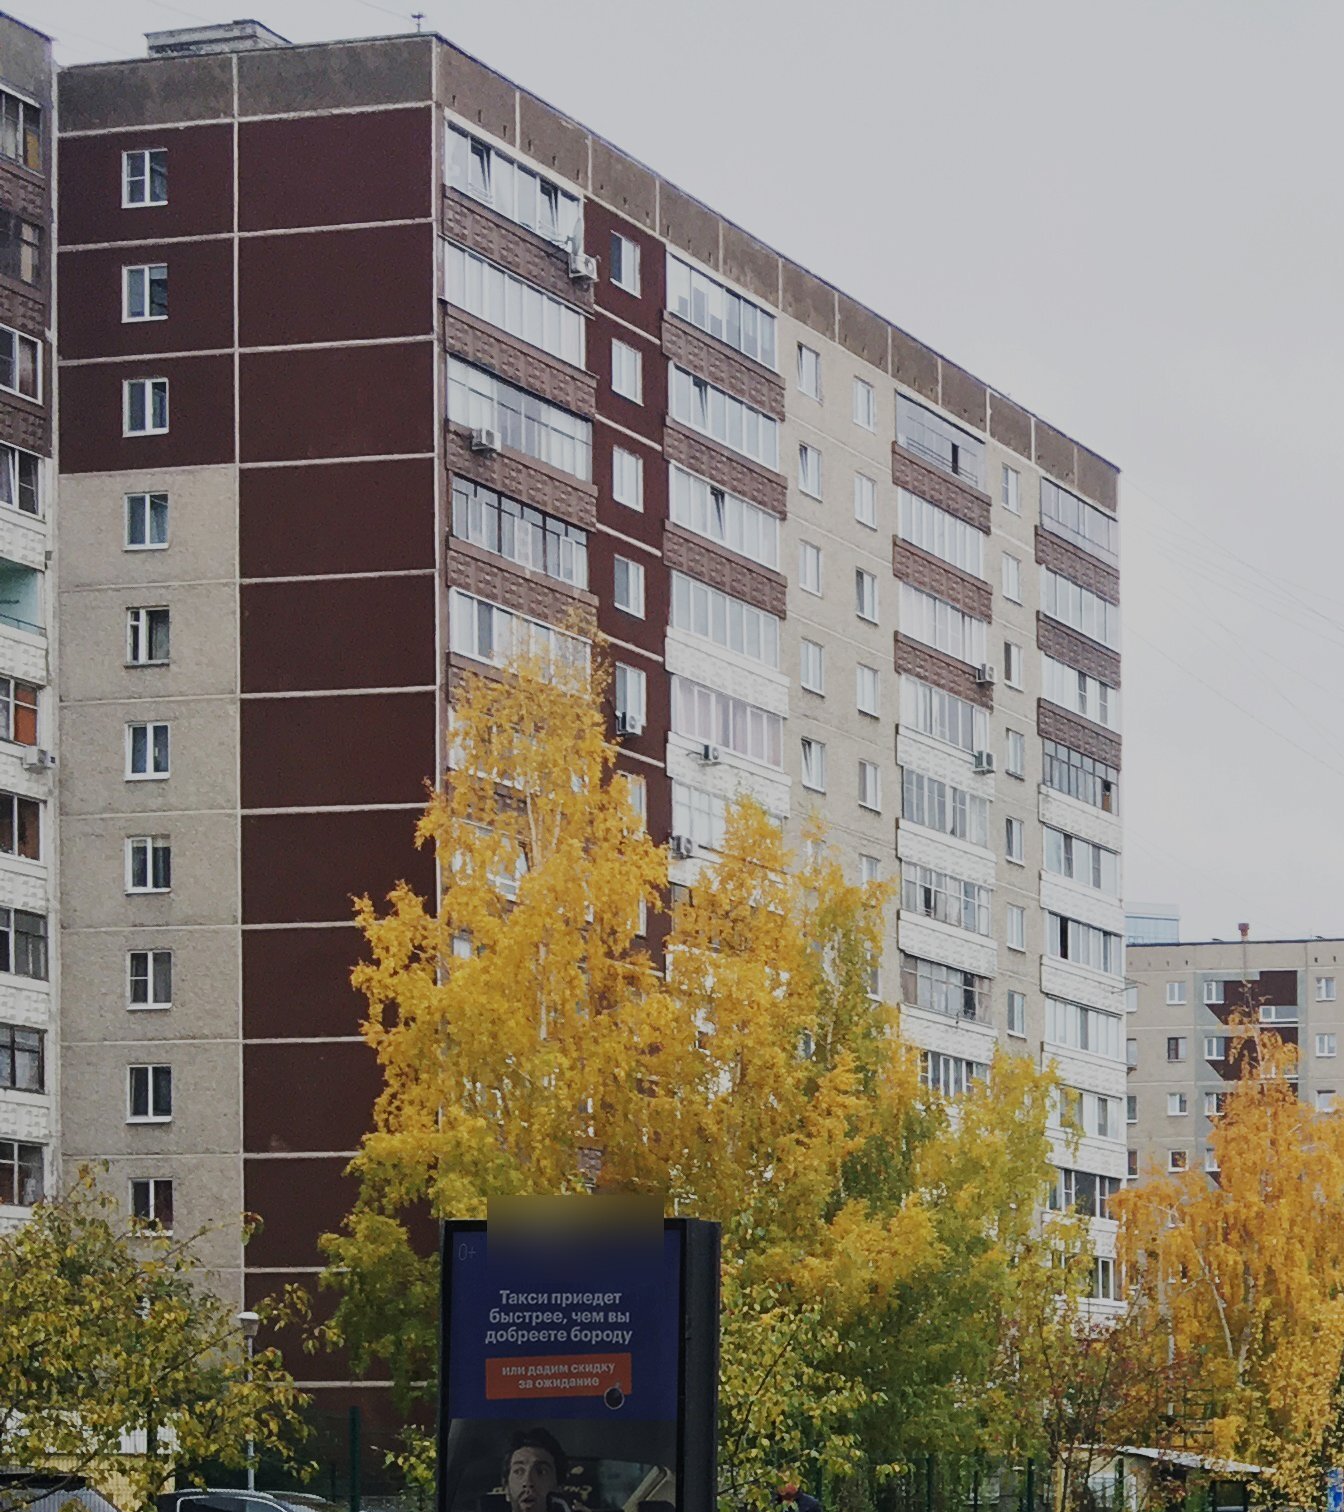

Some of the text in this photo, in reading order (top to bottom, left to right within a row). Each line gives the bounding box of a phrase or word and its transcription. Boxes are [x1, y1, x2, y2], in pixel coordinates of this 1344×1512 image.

[458, 1243, 477, 1261] 0+
[499, 1289, 622, 1307] Такси приедет
[489, 1308, 630, 1326] быстрее, чем вы
[485, 1326, 633, 1344] добреете бороду
[501, 1362, 616, 1377] или дадим скидку
[518, 1376, 600, 1389] за ожидание
